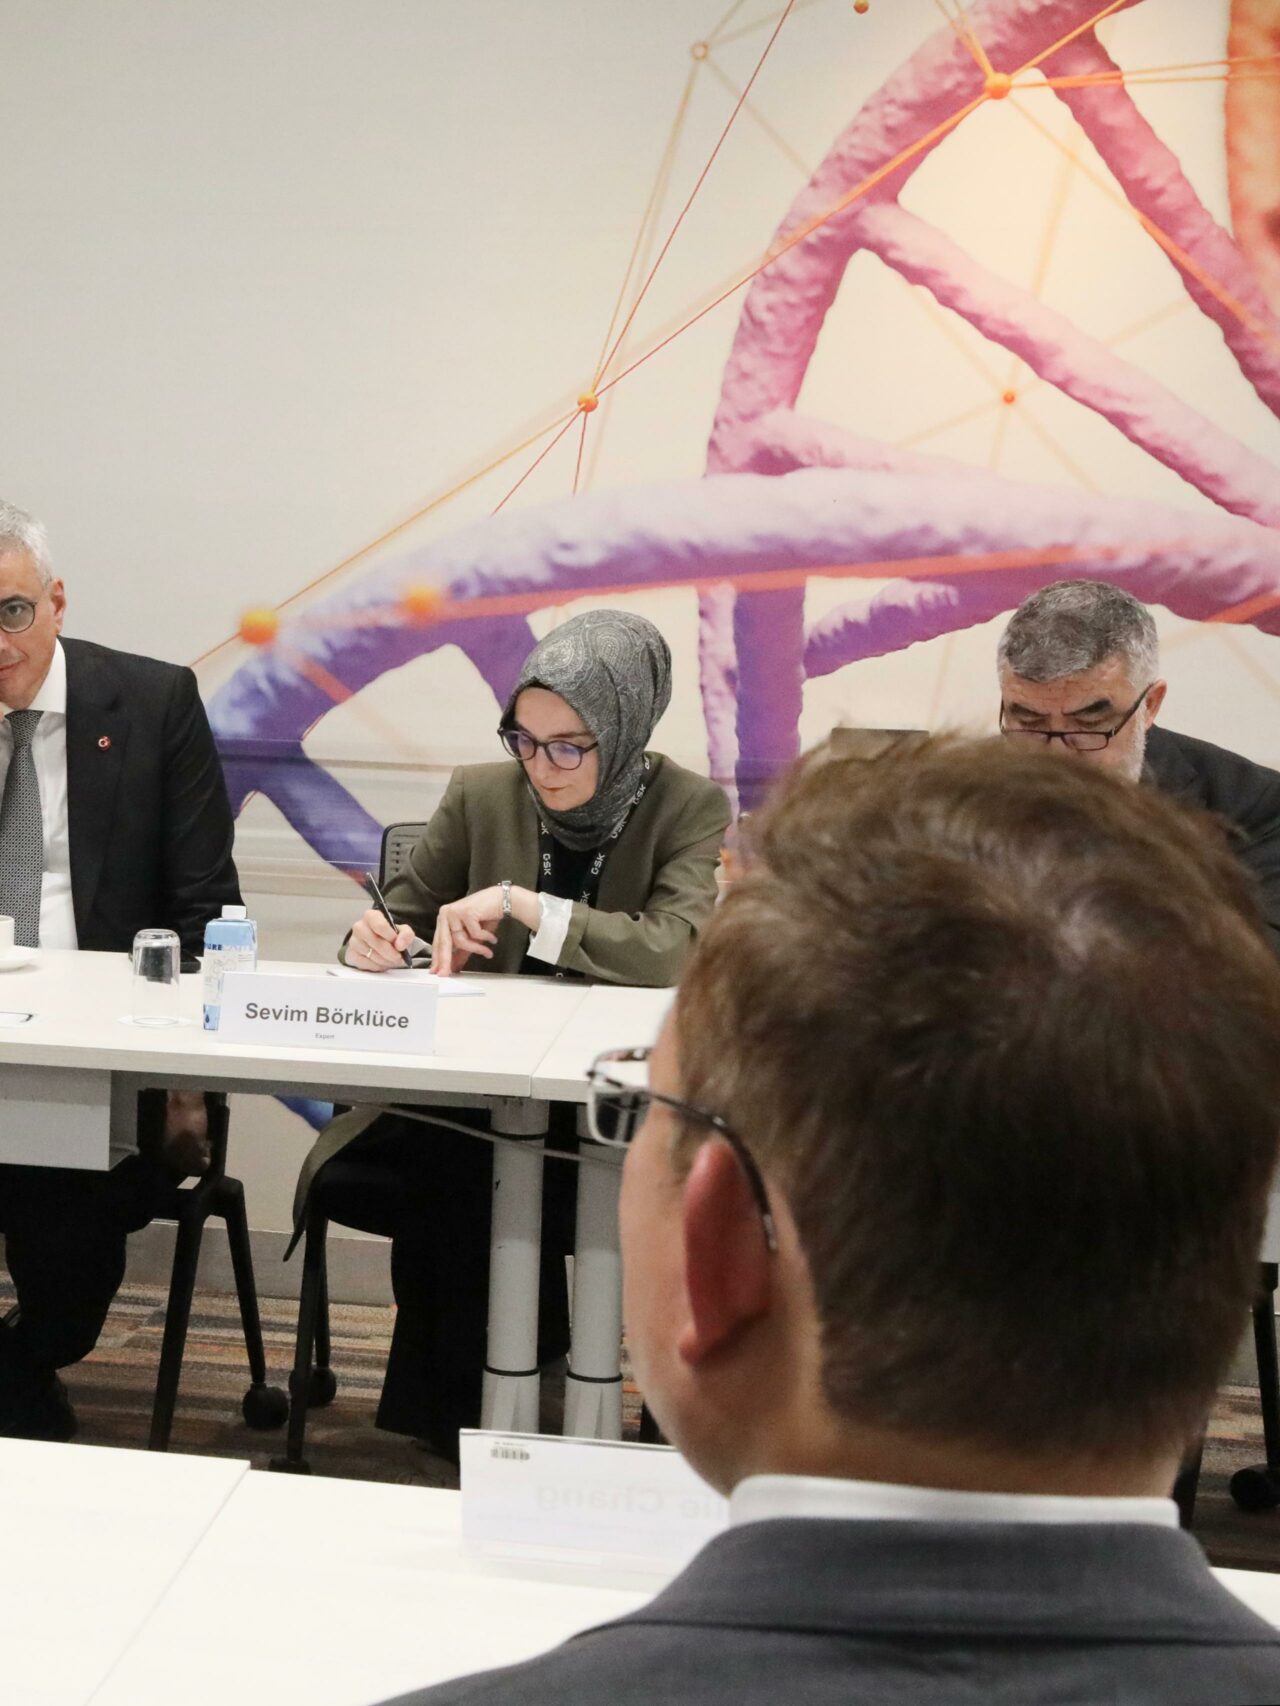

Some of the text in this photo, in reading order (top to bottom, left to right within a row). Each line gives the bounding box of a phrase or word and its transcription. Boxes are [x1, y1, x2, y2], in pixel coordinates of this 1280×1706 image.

[542, 854, 552, 876] GSK
[590, 852, 606, 876] GSK
[245, 1002, 410, 1028] Sevim Börklüce
[315, 1033, 335, 1041] Expert
